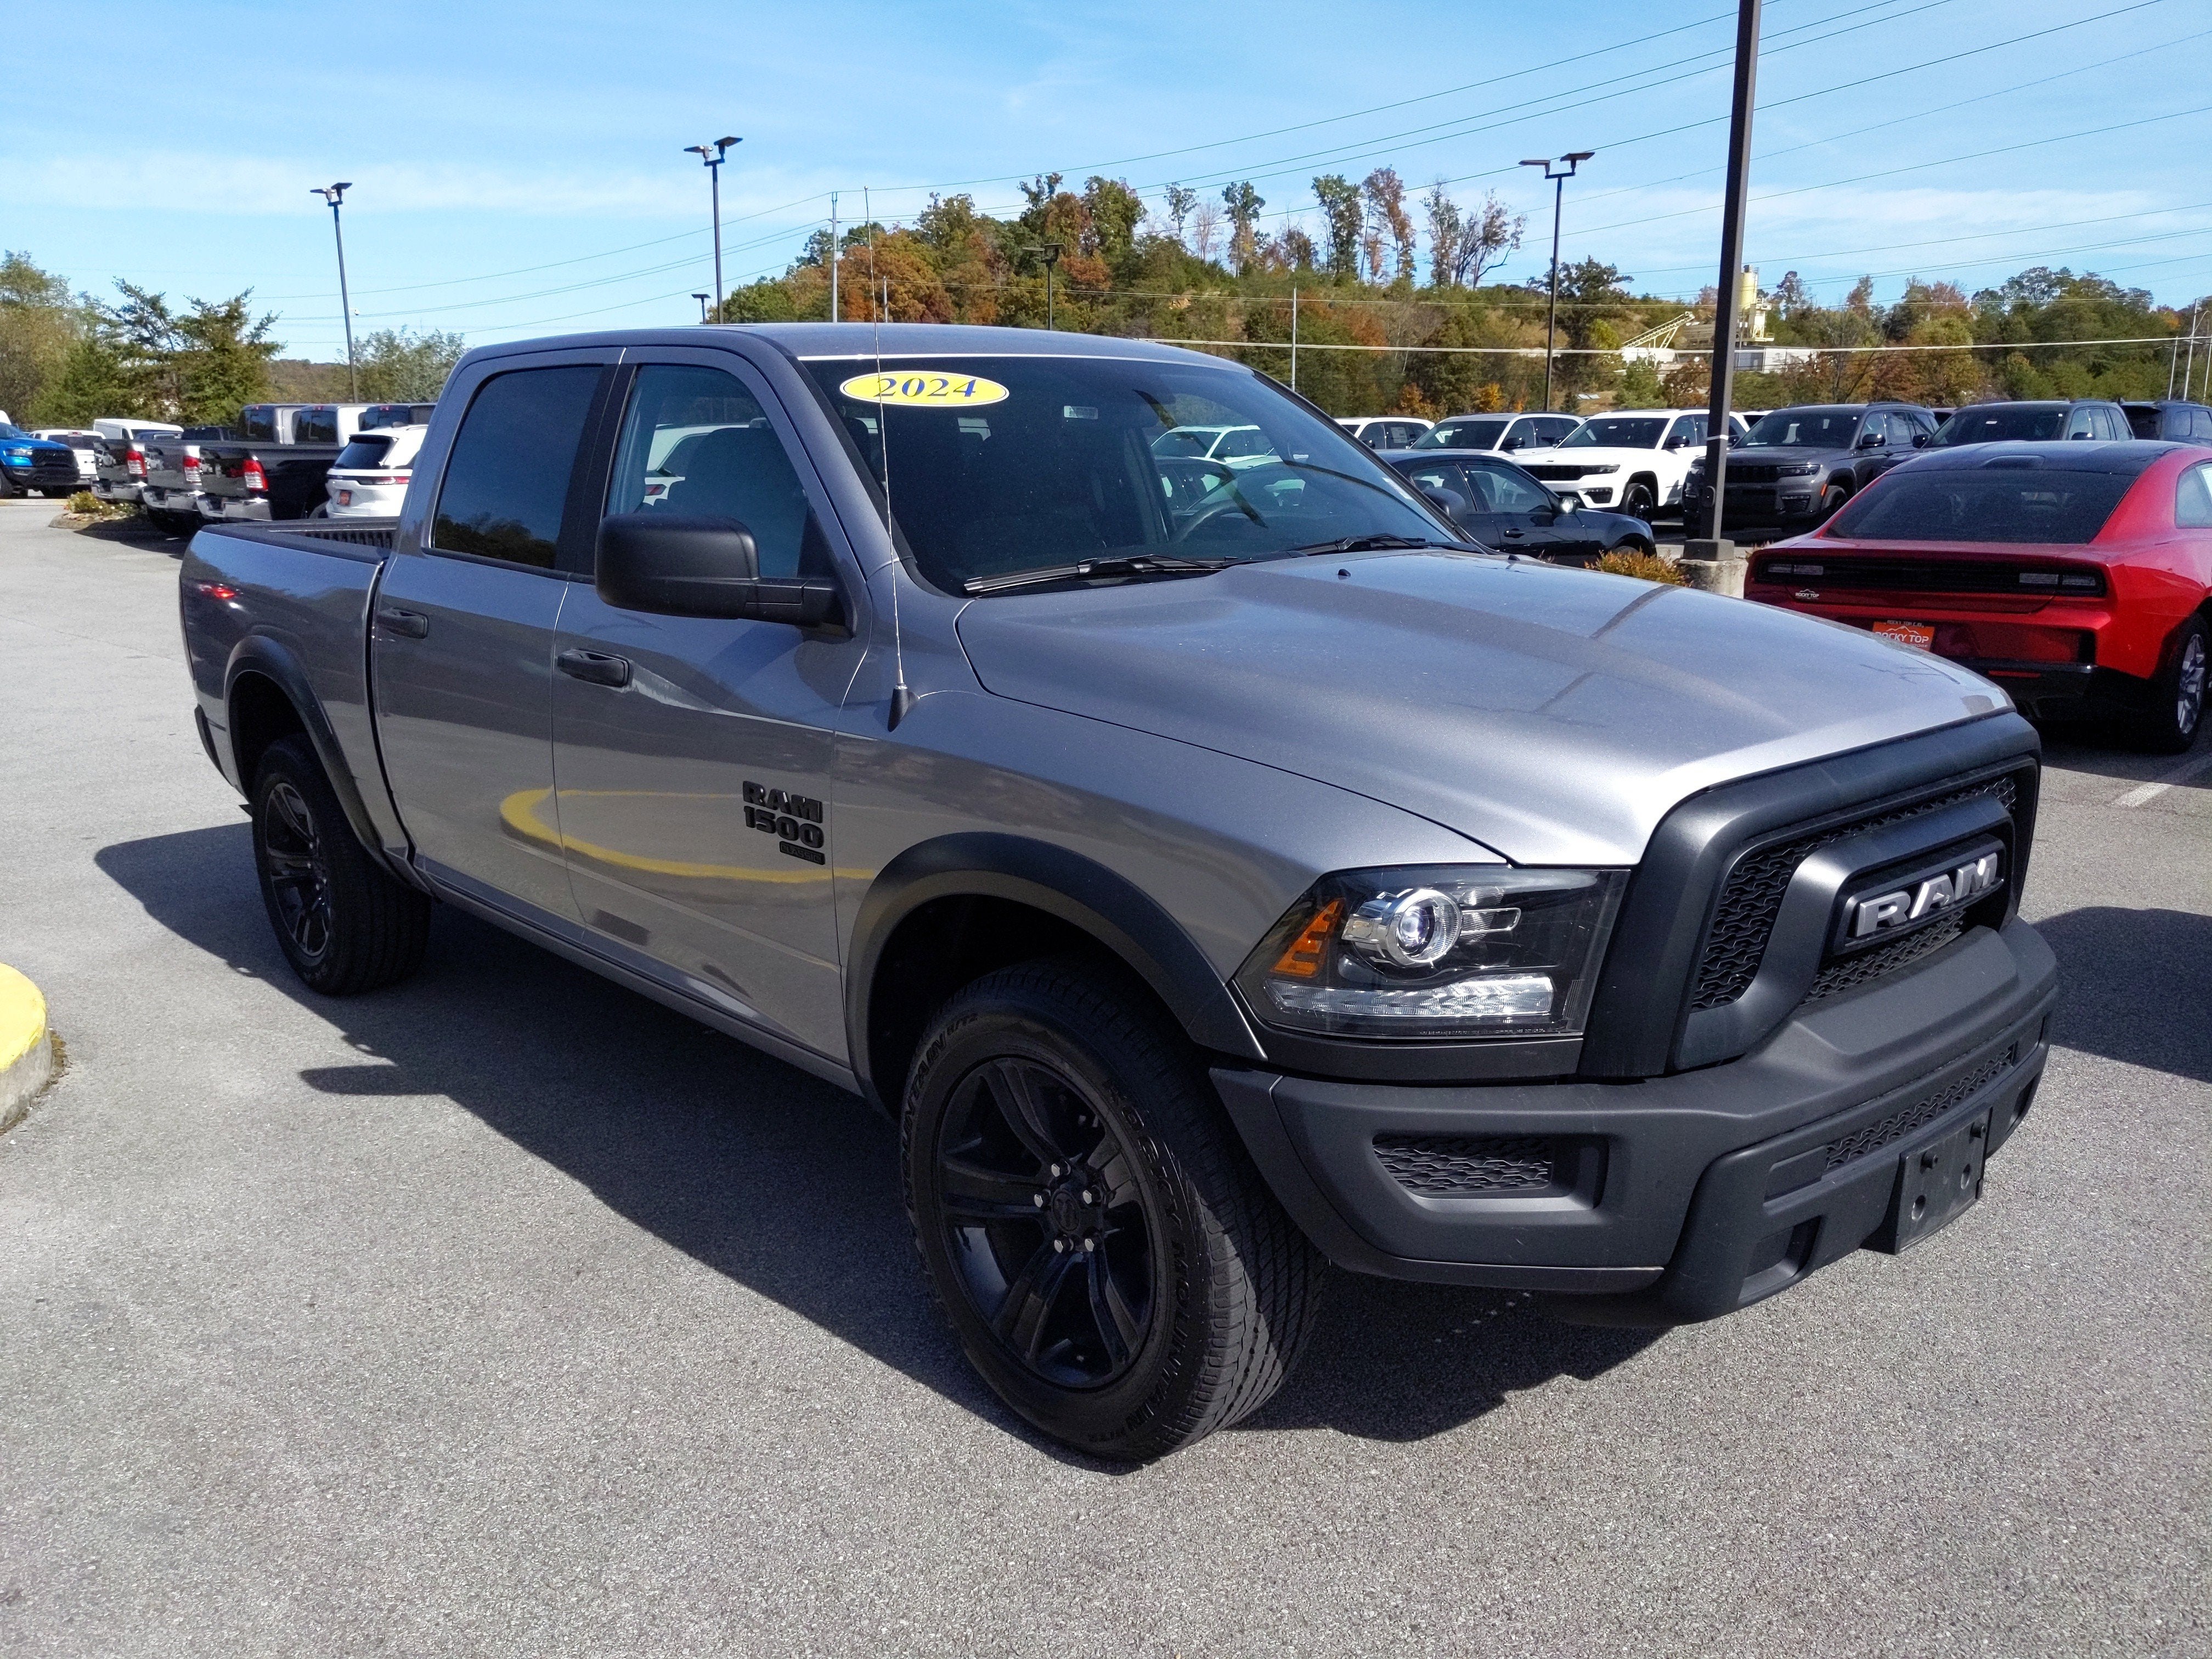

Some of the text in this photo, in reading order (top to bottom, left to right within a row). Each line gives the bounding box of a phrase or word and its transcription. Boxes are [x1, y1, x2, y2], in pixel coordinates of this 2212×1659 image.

[873, 377, 977, 398] 2024
[1909, 634, 1929, 644] TOP
[742, 780, 823, 824] RAM
[743, 805, 825, 849] 1500
[780, 842, 823, 864] CLASSIC
[1856, 852, 1998, 937] RAM
